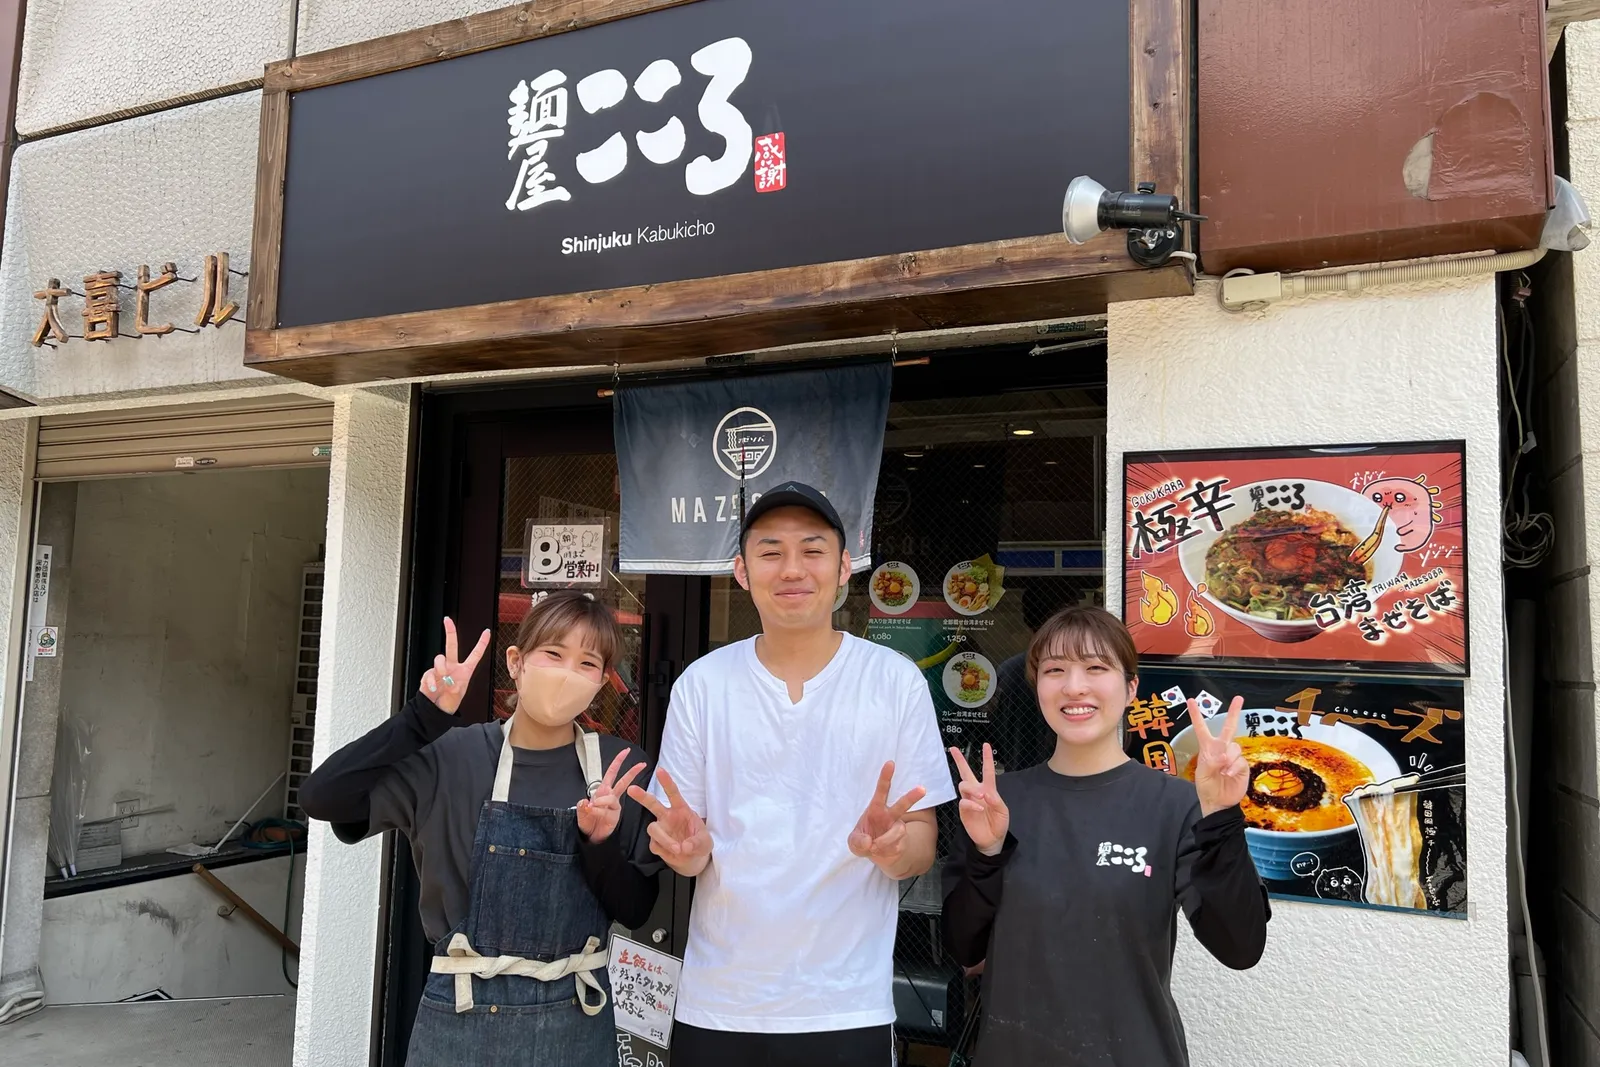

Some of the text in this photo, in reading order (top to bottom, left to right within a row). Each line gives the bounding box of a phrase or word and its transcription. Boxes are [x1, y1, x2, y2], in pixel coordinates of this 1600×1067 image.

[755, 132, 786, 191] 感謝
[561, 219, 715, 254] Shinjuku Kabukicho
[32, 252, 240, 348] 大喜ビル
[1131, 479, 1185, 509] GOKUKARA
[1132, 478, 1237, 558] 極辛
[532, 536, 563, 575] 8
[564, 560, 600, 579] 営業中!
[1310, 579, 1372, 629] 台湾
[1372, 573, 1408, 593] TAIWAN
[1358, 579, 1457, 642] まぜそば
[1127, 693, 1177, 777] 韓国
[1275, 687, 1461, 743] チーズ
